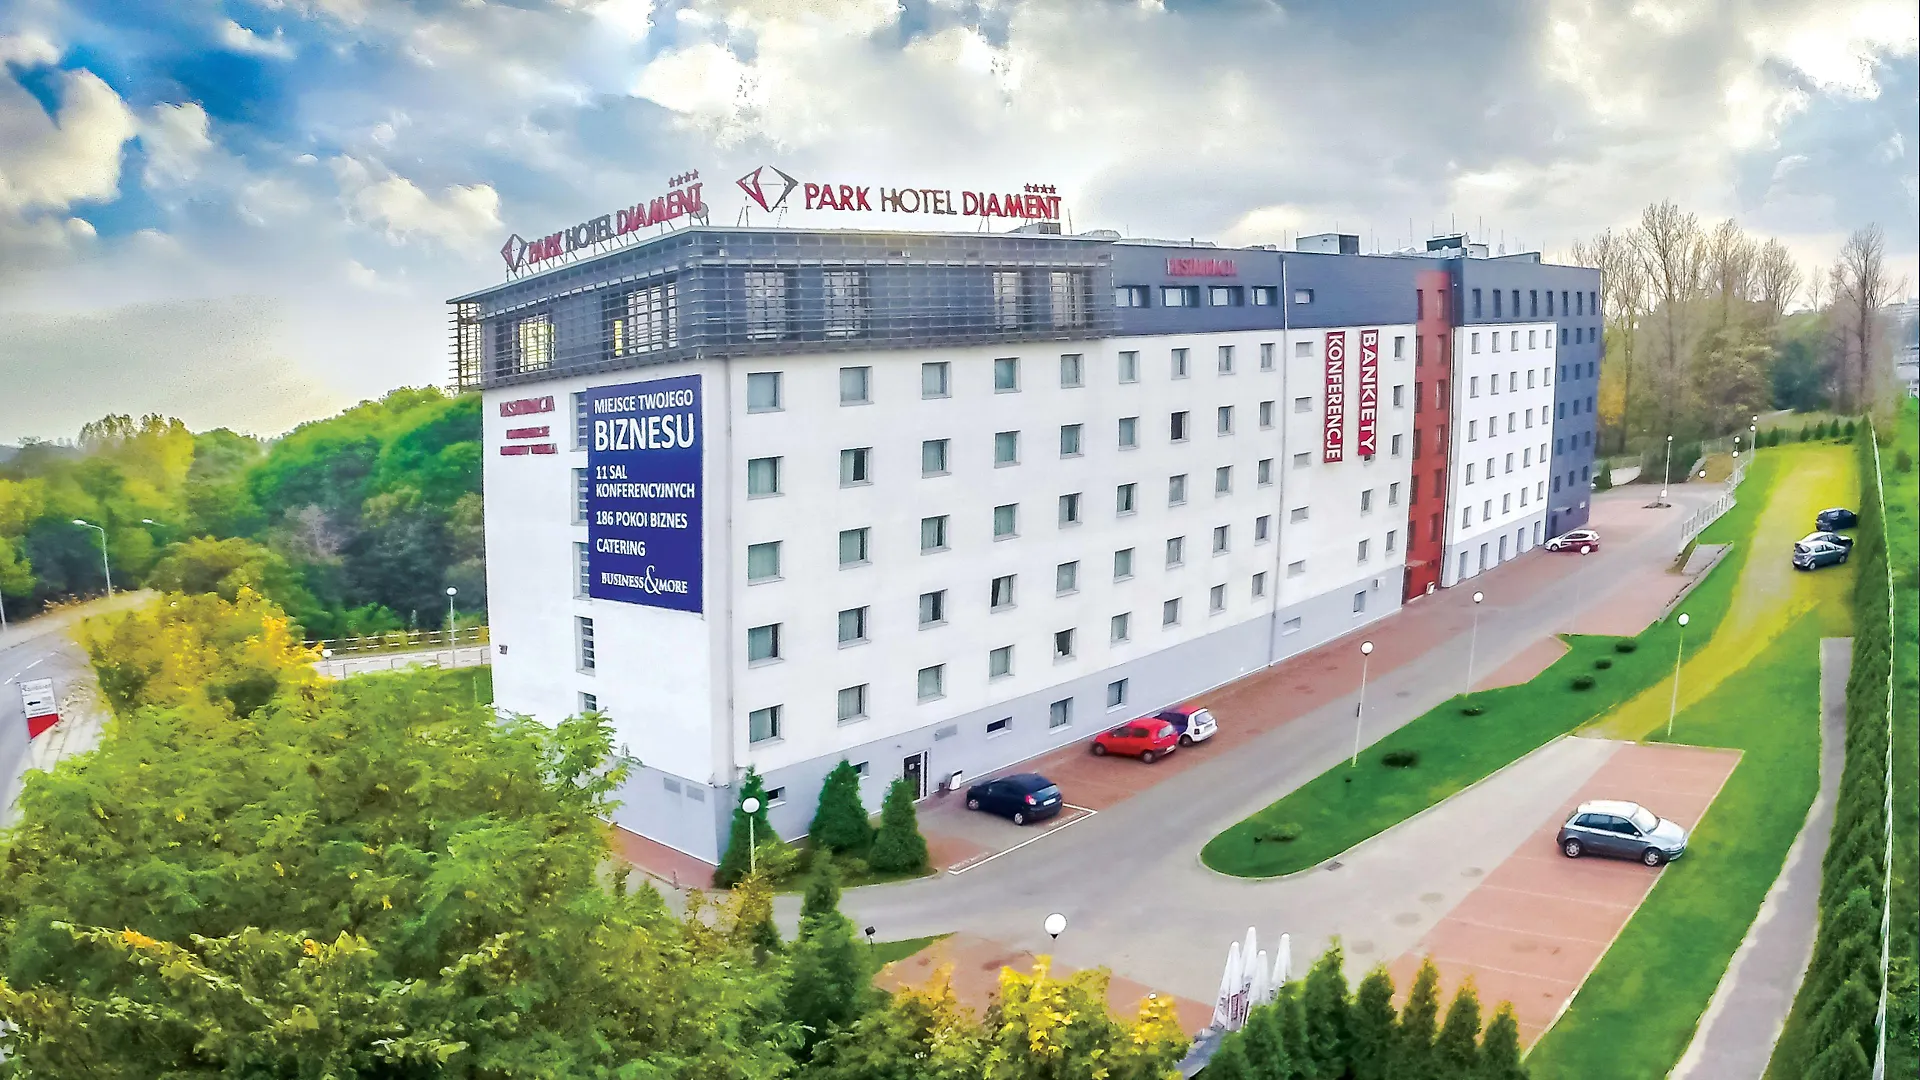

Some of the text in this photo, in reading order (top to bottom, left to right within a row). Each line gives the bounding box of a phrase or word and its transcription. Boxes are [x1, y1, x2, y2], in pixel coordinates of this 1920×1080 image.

[803, 182, 1062, 220] PARK HOTEL DIAMENT
[528, 182, 704, 265] PARK HOTEL DIAMENT
[594, 389, 694, 414] MIEJSCE TWOJEGO
[1326, 334, 1344, 459] KONFERENCJE
[1360, 332, 1377, 451] BANKIETY
[594, 412, 695, 451] BIZNESU
[596, 464, 628, 480] 11 SAL
[596, 482, 696, 499] KONFERENCYJNYCH
[596, 510, 688, 529] 186 POKOI BIZNES
[596, 538, 646, 557] CATERING
